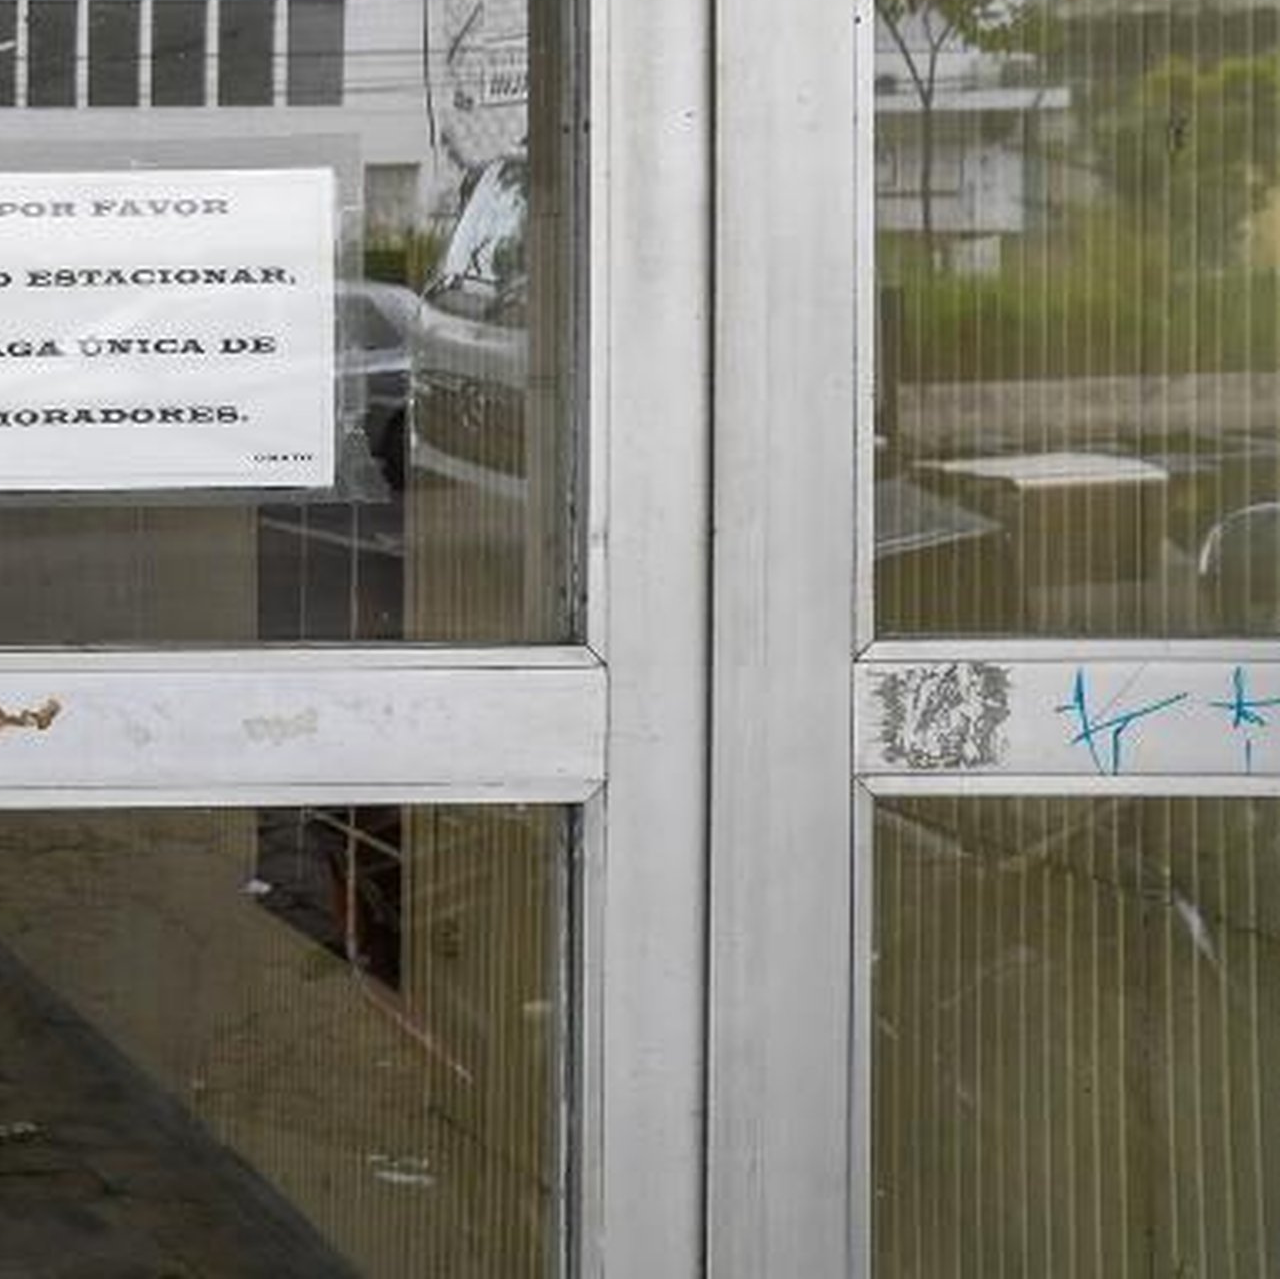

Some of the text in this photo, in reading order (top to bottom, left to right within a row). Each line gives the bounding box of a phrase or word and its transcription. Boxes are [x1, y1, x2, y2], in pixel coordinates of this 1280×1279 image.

[91, 197, 230, 217] FAVOR
[25, 267, 297, 288] ESTACIONAR,
[78, 335, 206, 358] ÚNICA
[218, 336, 278, 355] DE
